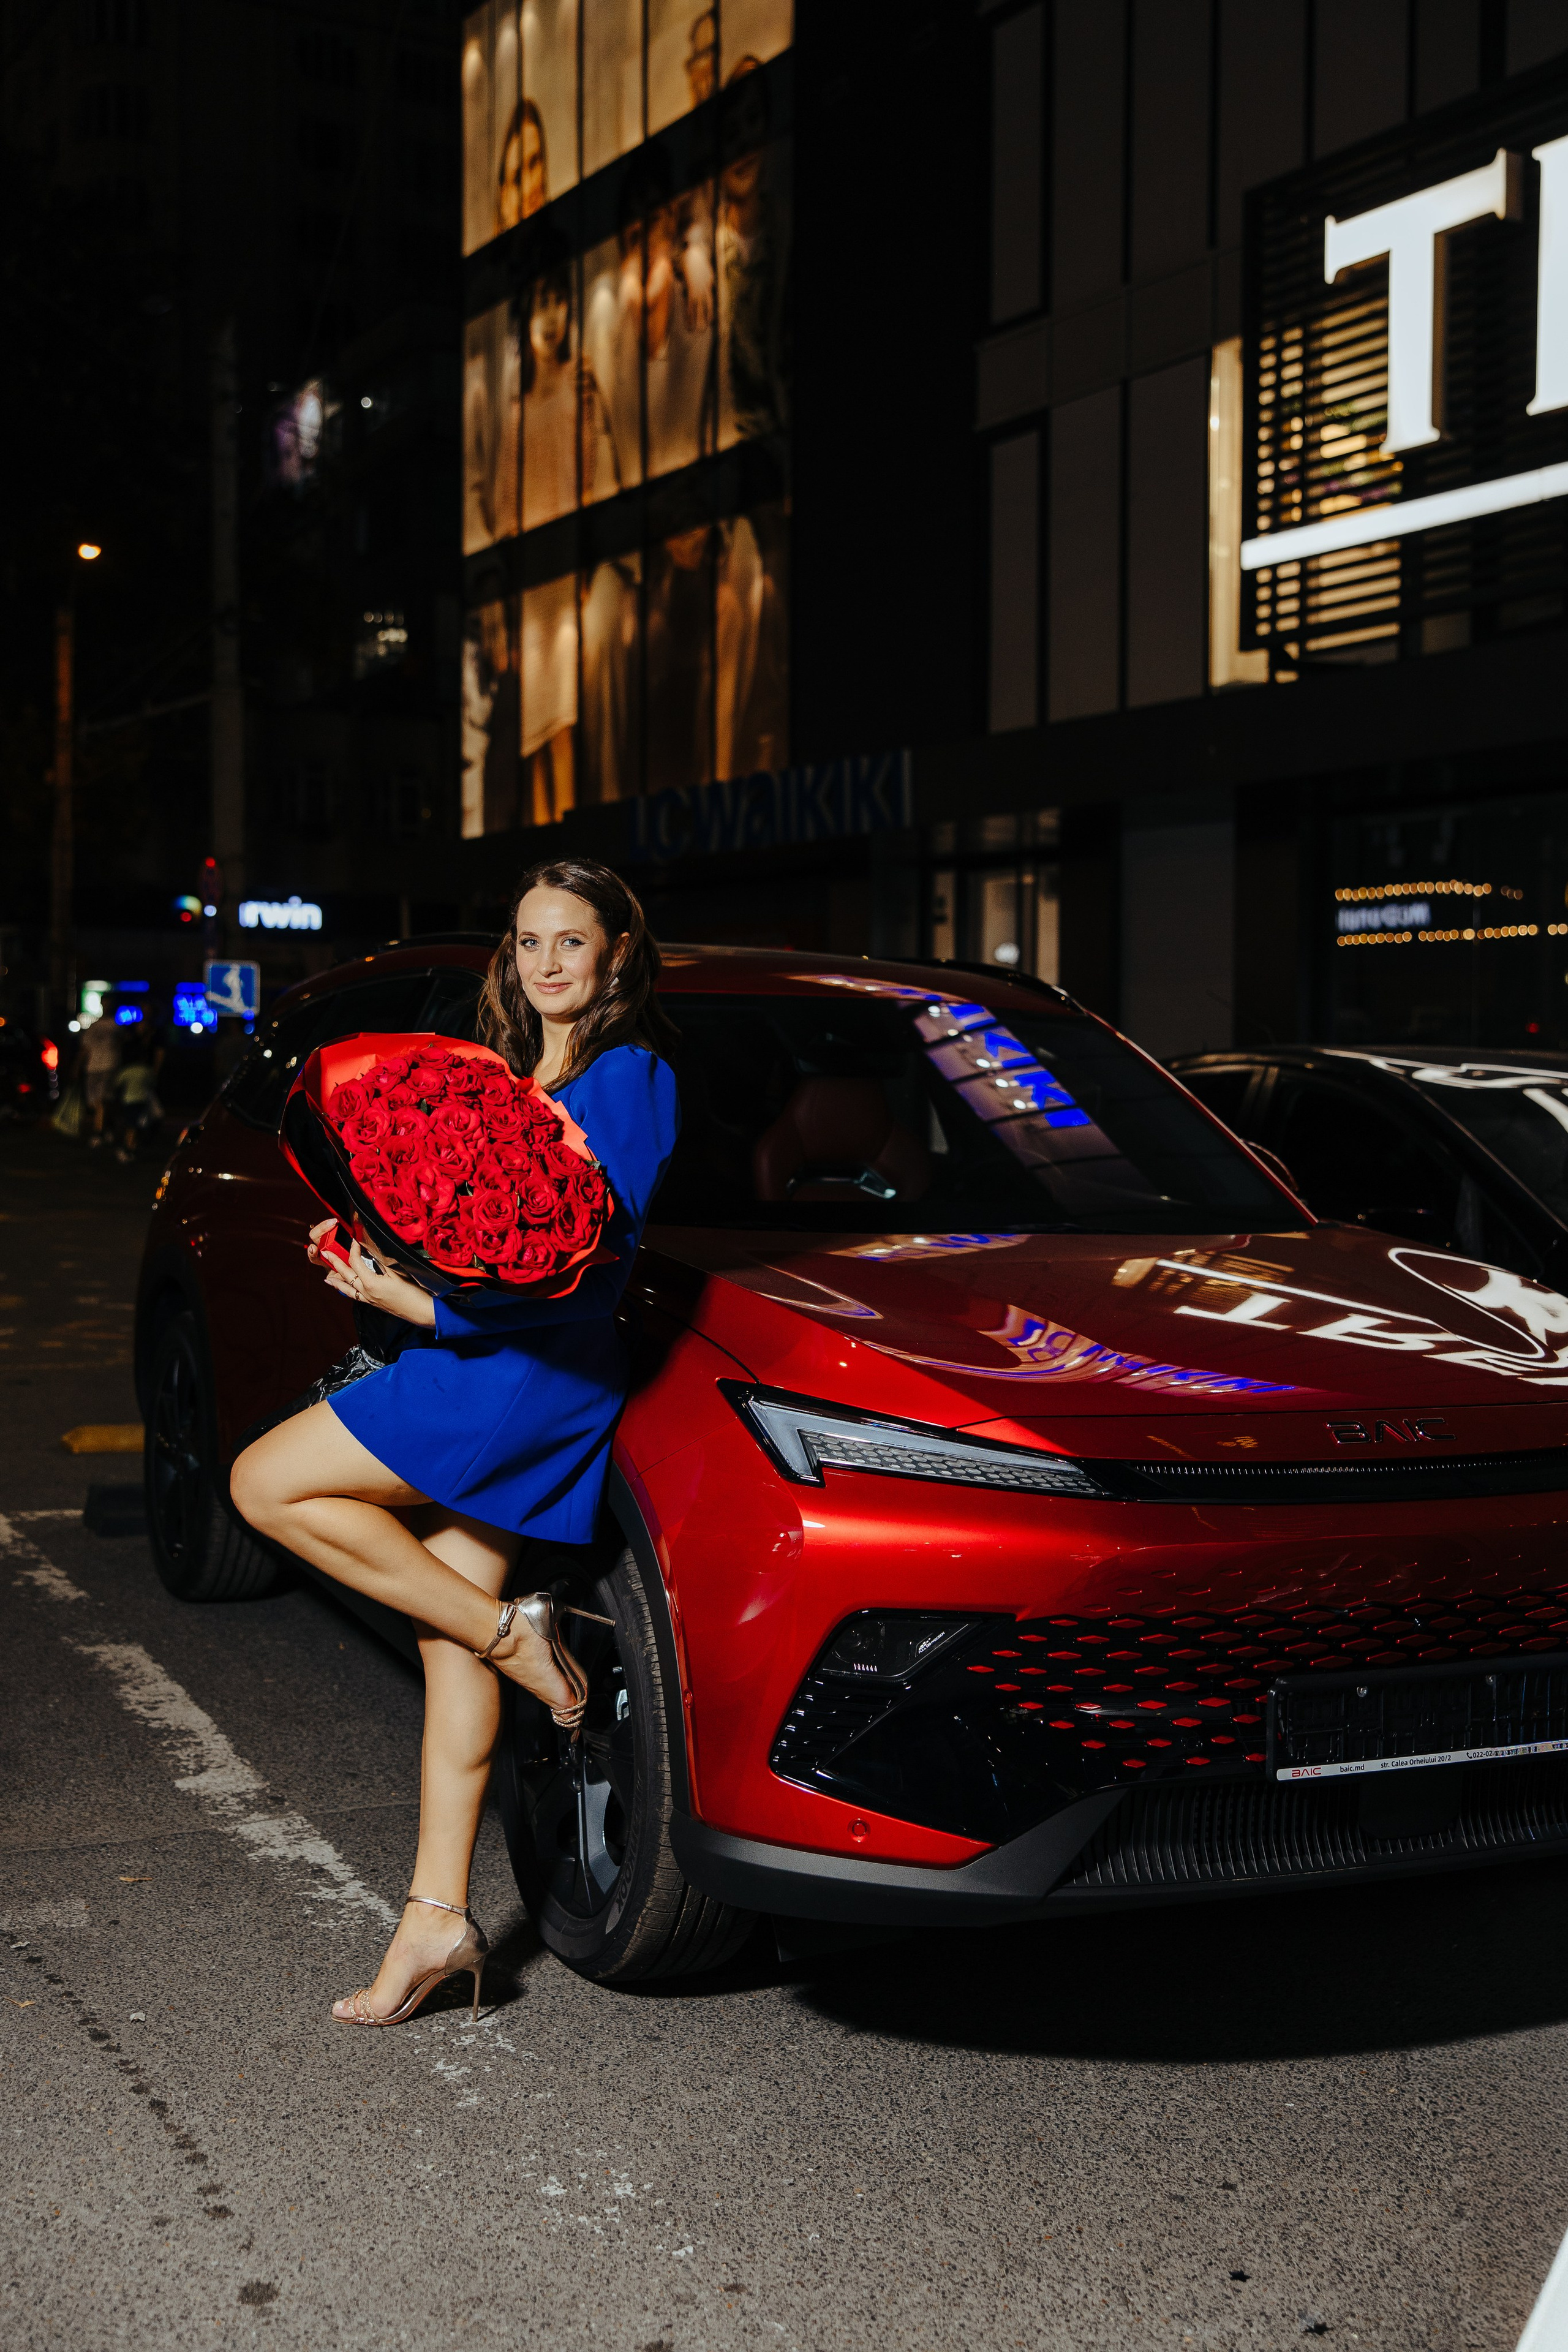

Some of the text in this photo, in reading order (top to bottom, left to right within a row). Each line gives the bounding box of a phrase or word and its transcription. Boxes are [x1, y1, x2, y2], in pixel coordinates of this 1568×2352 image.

[1326, 1417, 1457, 1444] BAIC
[1292, 1767, 1322, 1777] BAIC
[1340, 1764, 1365, 1773] baic.md
[1381, 1760, 1390, 1768] str.
[1391, 1758, 1408, 1767] Calea
[1409, 1755, 1436, 1765] Orheiului
